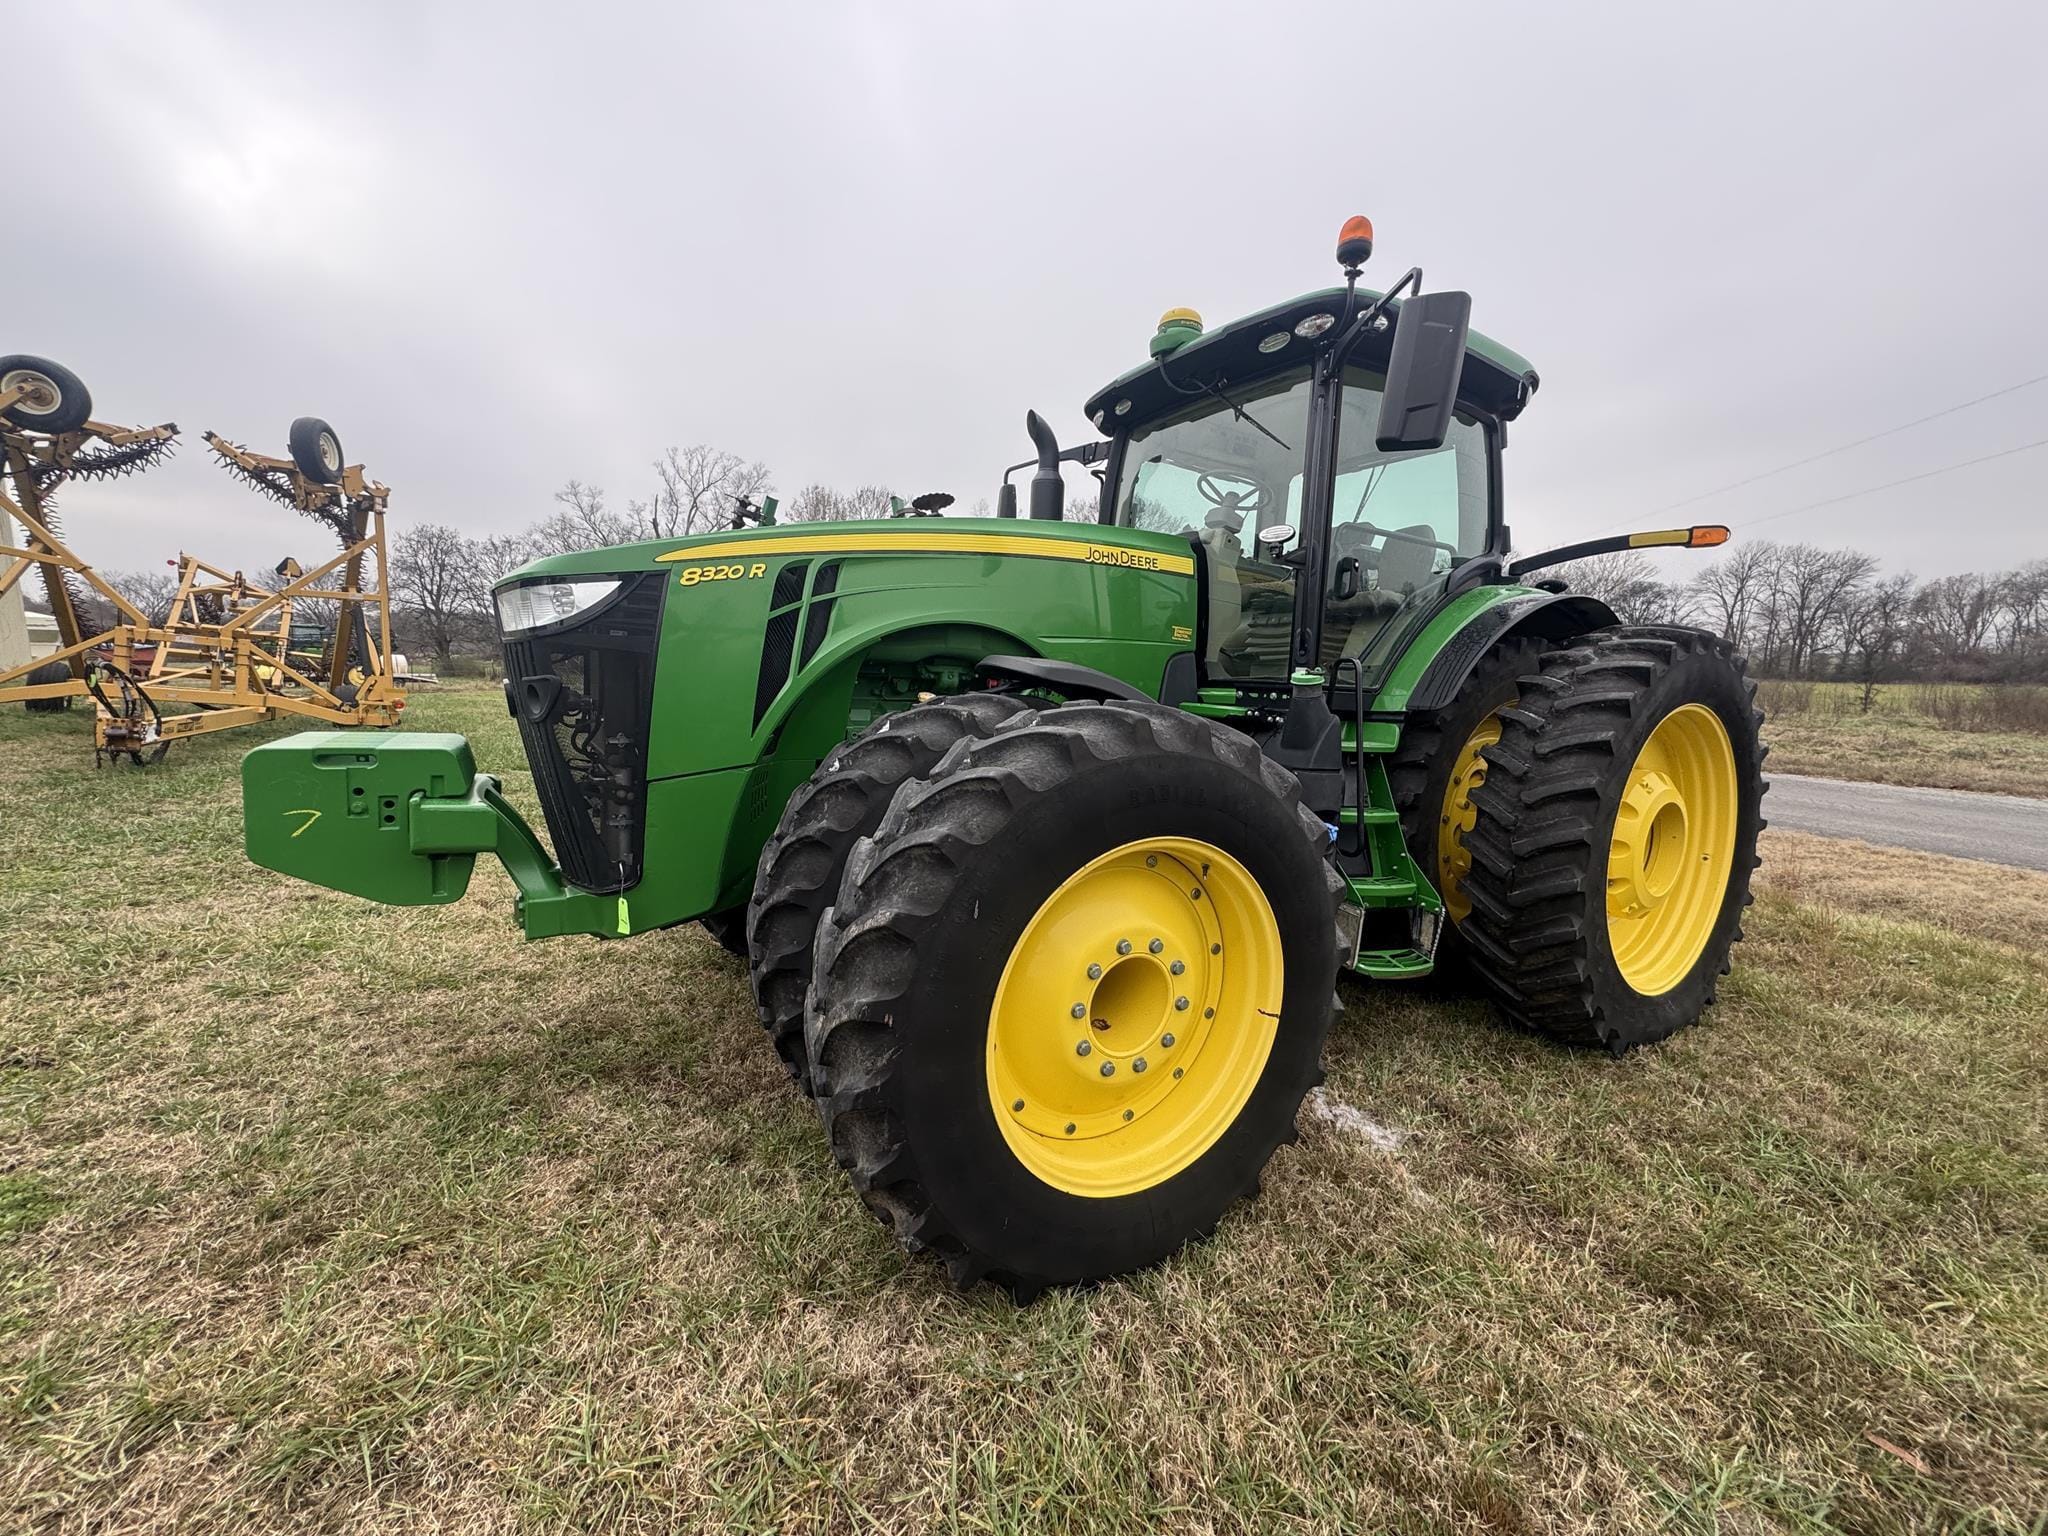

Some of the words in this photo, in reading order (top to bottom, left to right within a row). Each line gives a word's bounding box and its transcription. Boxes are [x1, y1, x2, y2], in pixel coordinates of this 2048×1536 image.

[680, 564, 745, 586] 8320
[748, 563, 766, 579] R
[283, 809, 322, 838] 7
